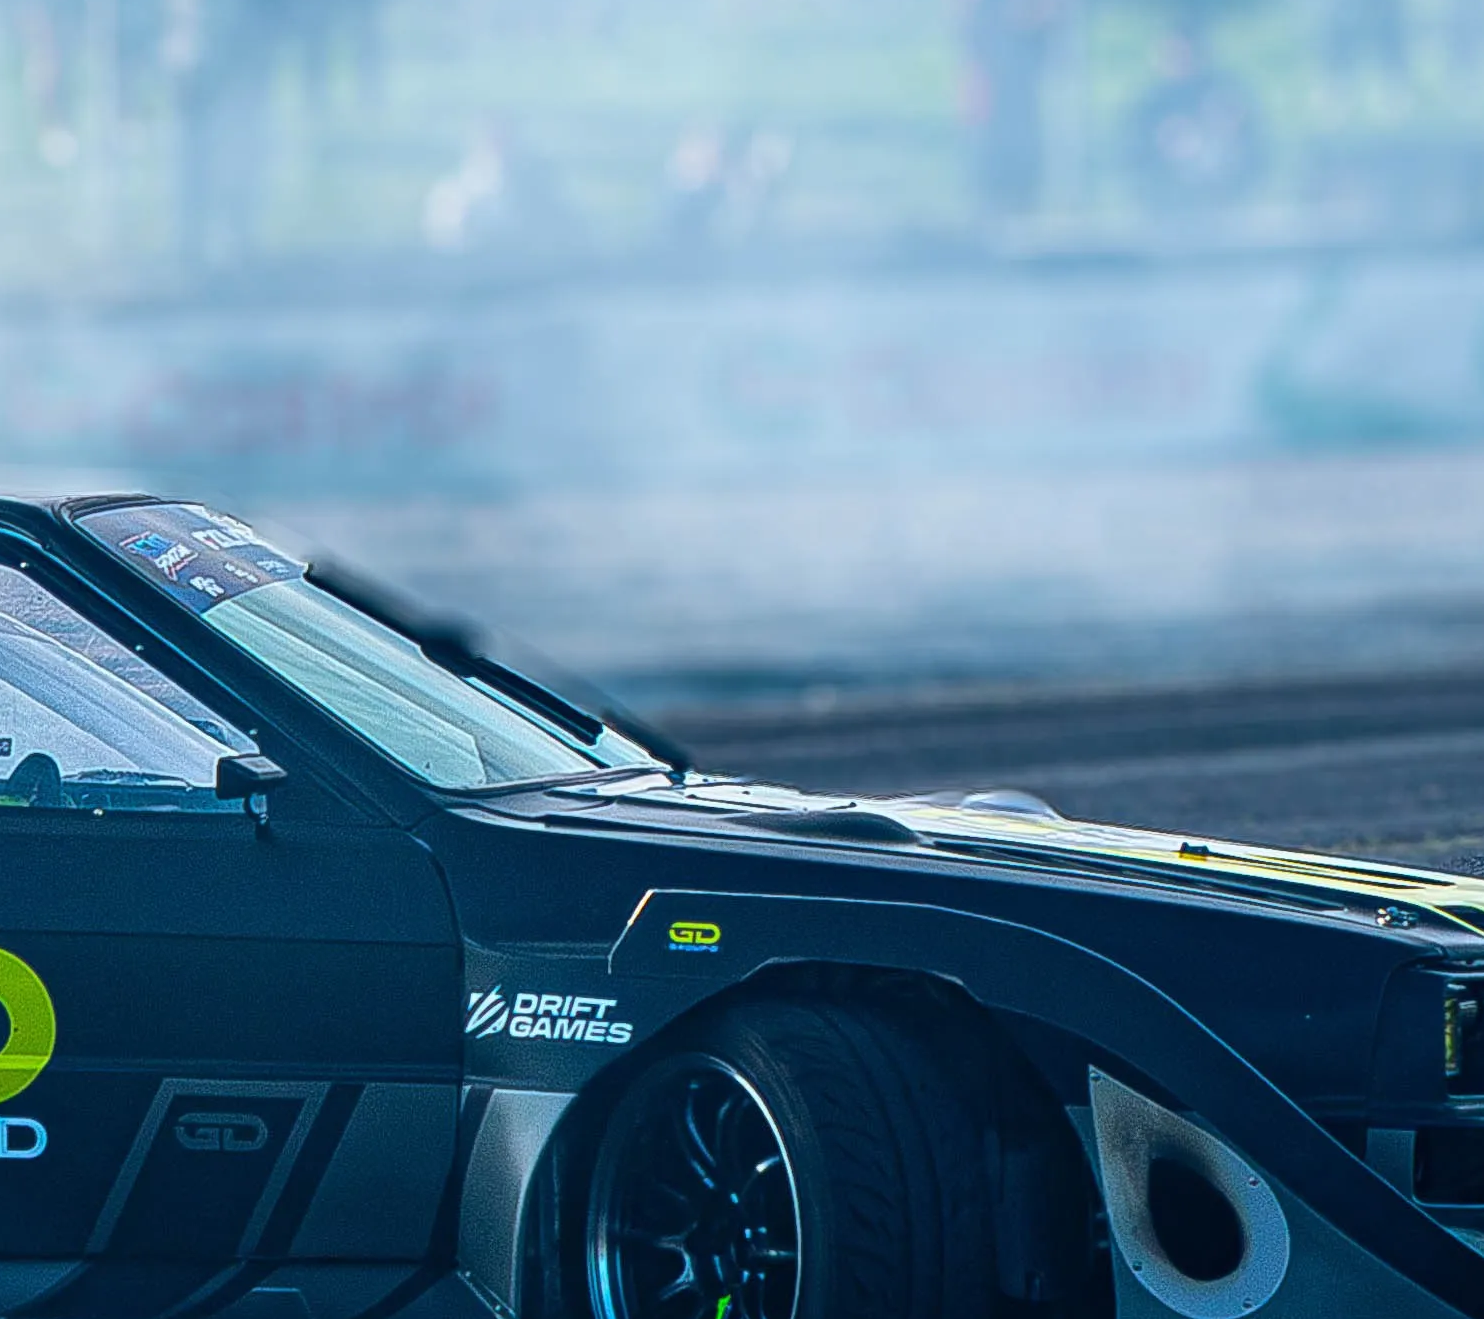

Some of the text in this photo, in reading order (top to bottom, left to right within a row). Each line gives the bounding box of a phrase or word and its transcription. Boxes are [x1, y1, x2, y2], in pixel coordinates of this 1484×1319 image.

[669, 922, 721, 944] GD
[512, 992, 618, 1019] DRIFT
[509, 1016, 634, 1043] GAMES
